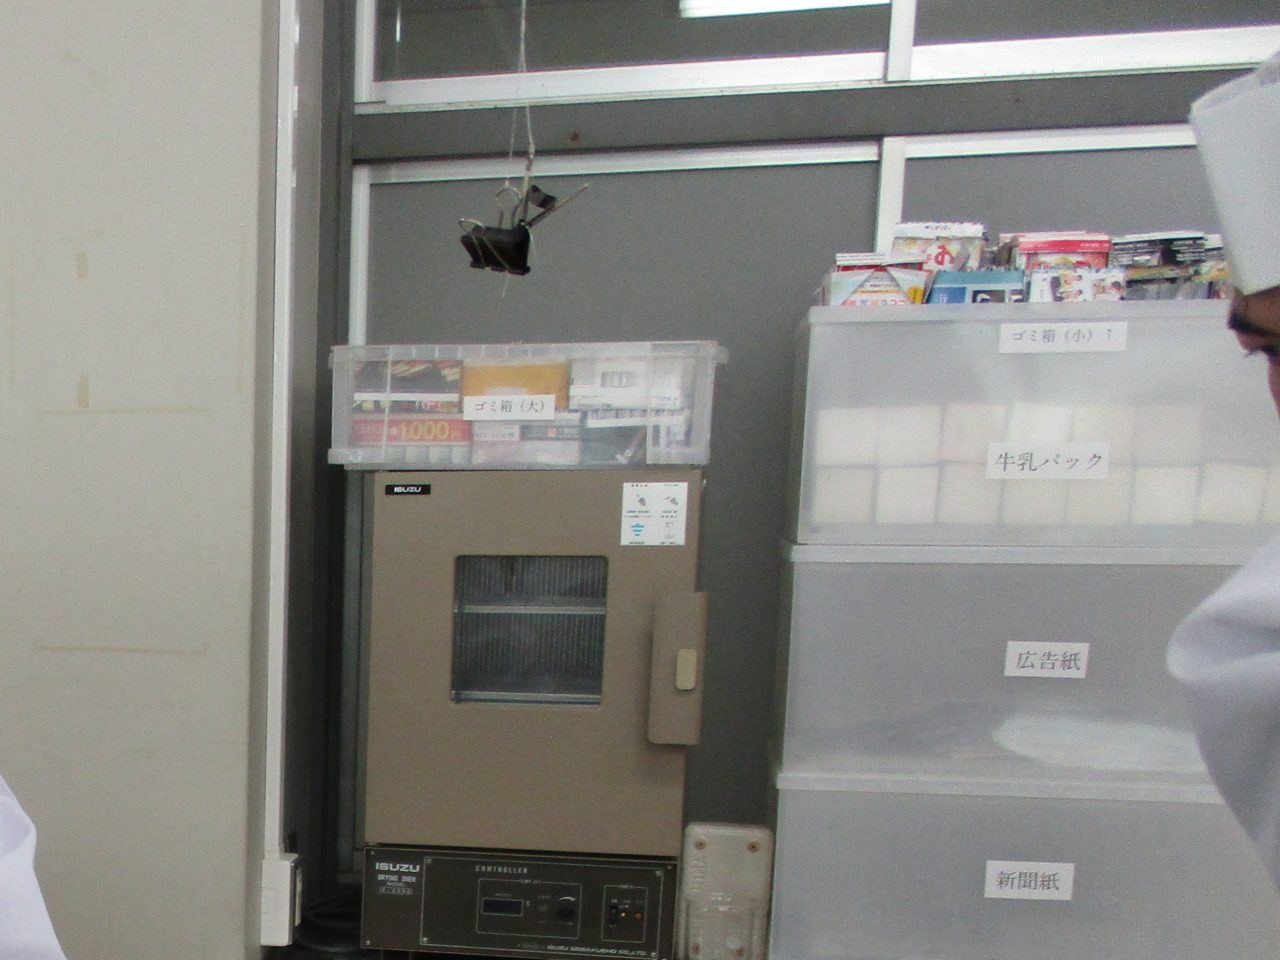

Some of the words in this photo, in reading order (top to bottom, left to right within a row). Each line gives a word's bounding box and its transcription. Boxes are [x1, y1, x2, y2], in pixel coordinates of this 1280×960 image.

[995, 451, 1104, 473] 牛乳パック
[1016, 651, 1081, 671] 広告紙
[375, 862, 420, 873] ISUZU
[475, 865, 528, 875] CONTROLLER
[996, 870, 1061, 892] 新聞紙
